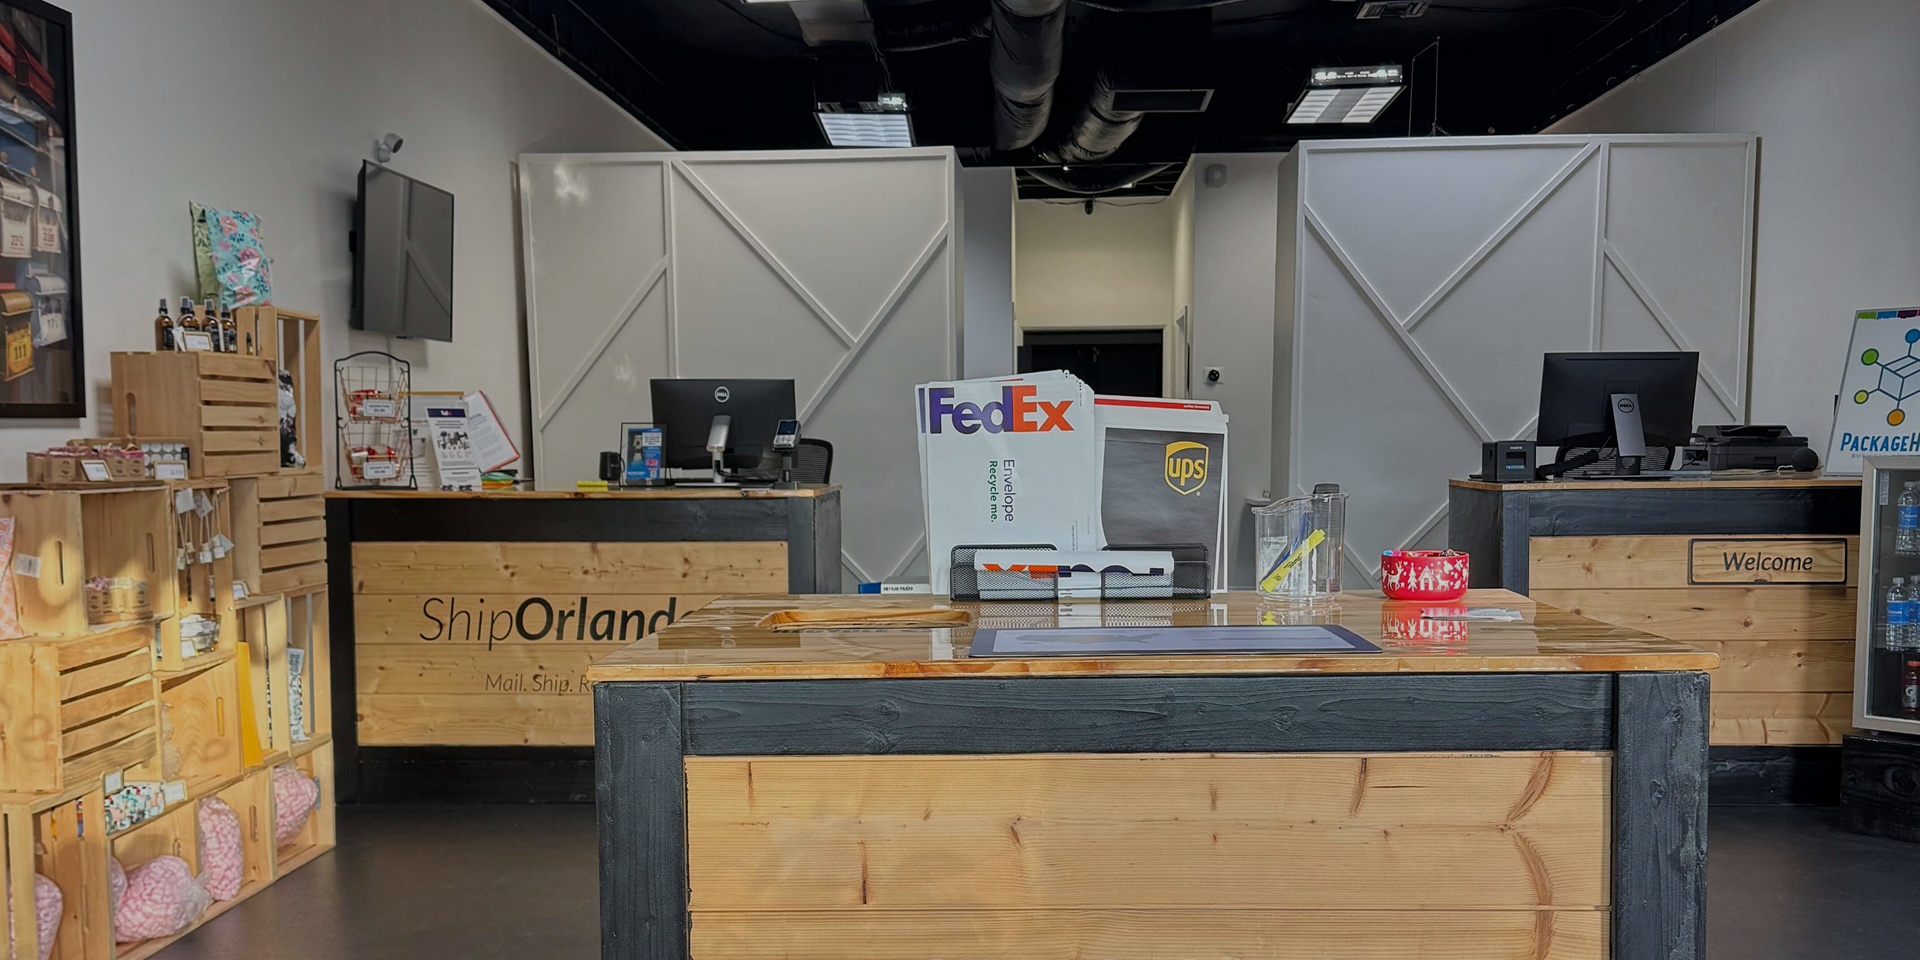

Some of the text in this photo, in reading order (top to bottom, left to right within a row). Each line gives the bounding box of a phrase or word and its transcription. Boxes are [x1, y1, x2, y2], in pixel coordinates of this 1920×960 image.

[929, 385, 1075, 434] FedEx
[988, 460, 999, 523] Recycle me.
[1002, 459, 1016, 522] Envelope
[1168, 458, 1205, 487] ups
[1723, 551, 1814, 571] Welcome
[419, 596, 697, 652] ShipOrland
[485, 673, 527, 693] Mail.
[532, 673, 574, 696] Ship.
